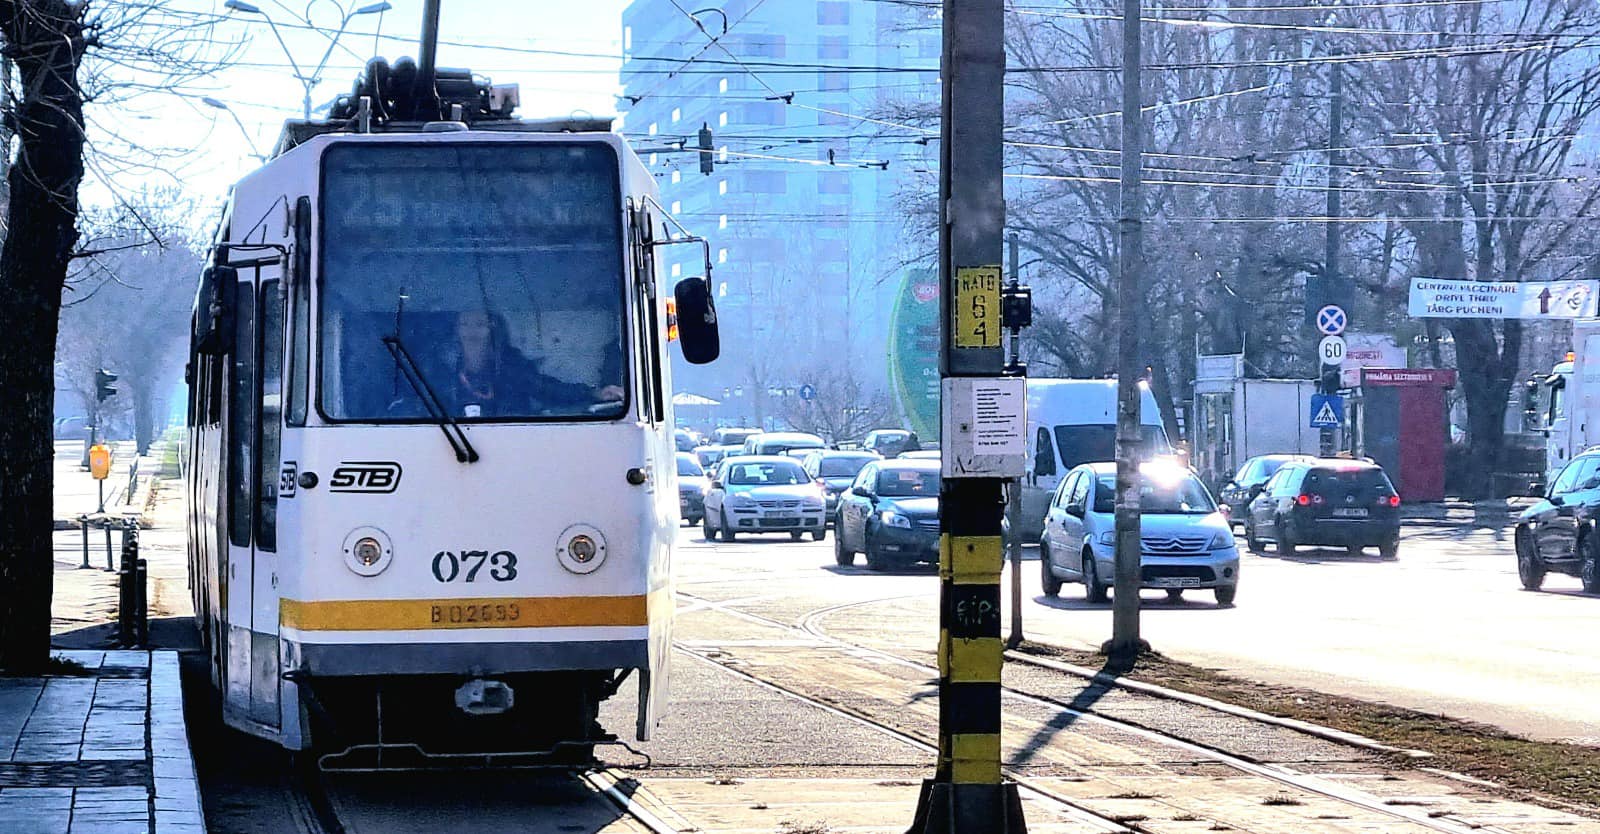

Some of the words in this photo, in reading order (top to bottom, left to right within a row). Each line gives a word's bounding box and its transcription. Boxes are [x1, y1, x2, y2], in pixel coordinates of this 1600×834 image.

[1460, 284, 1519, 294] VACCINARE
[972, 295, 986, 319] 6
[973, 321, 987, 345] 4
[1324, 343, 1342, 358] 60
[279, 467, 296, 491] STB
[329, 467, 396, 488] STB
[431, 550, 518, 583] 073
